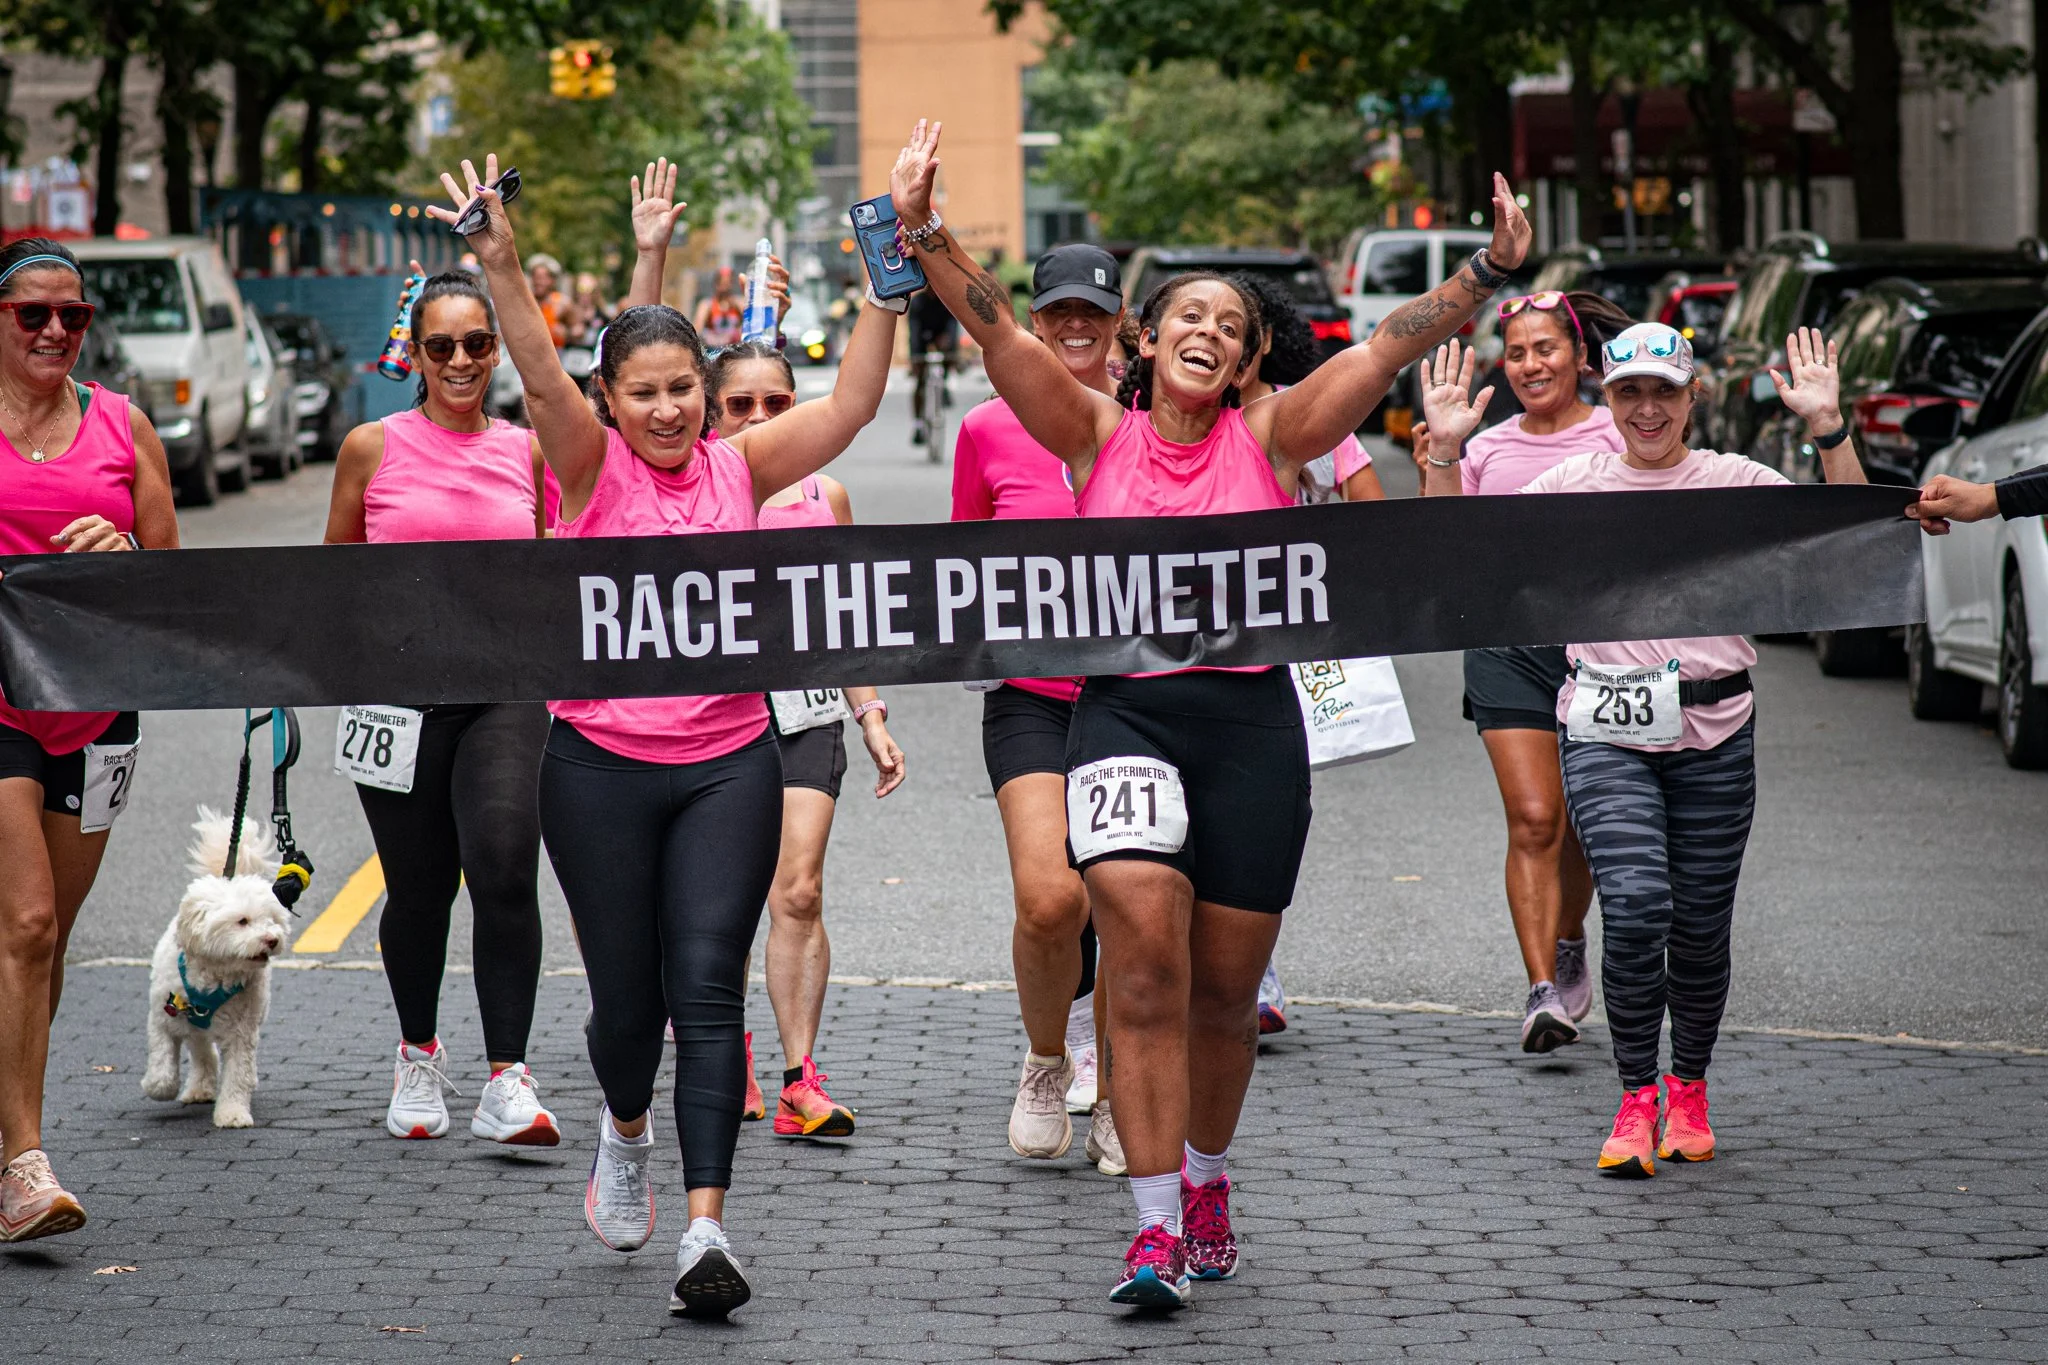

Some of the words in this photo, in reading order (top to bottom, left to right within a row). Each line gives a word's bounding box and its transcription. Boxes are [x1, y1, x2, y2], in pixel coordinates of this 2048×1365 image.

[579, 569, 759, 660] RACE
[777, 560, 914, 651] THE
[935, 542, 1330, 644] PERIMETER
[1616, 672, 1662, 685] PERIMETER
[1313, 697, 1354, 720] Pain
[1593, 685, 1654, 726] 253
[365, 710, 407, 727] PERIMETER
[1317, 719, 1360, 733] QUOTIDIEN
[342, 718, 394, 768] 278
[1080, 771, 1097, 788] RACE
[1099, 767, 1115, 780] THE
[1117, 766, 1168, 781] PERIMETER
[1089, 781, 1156, 833] 241
